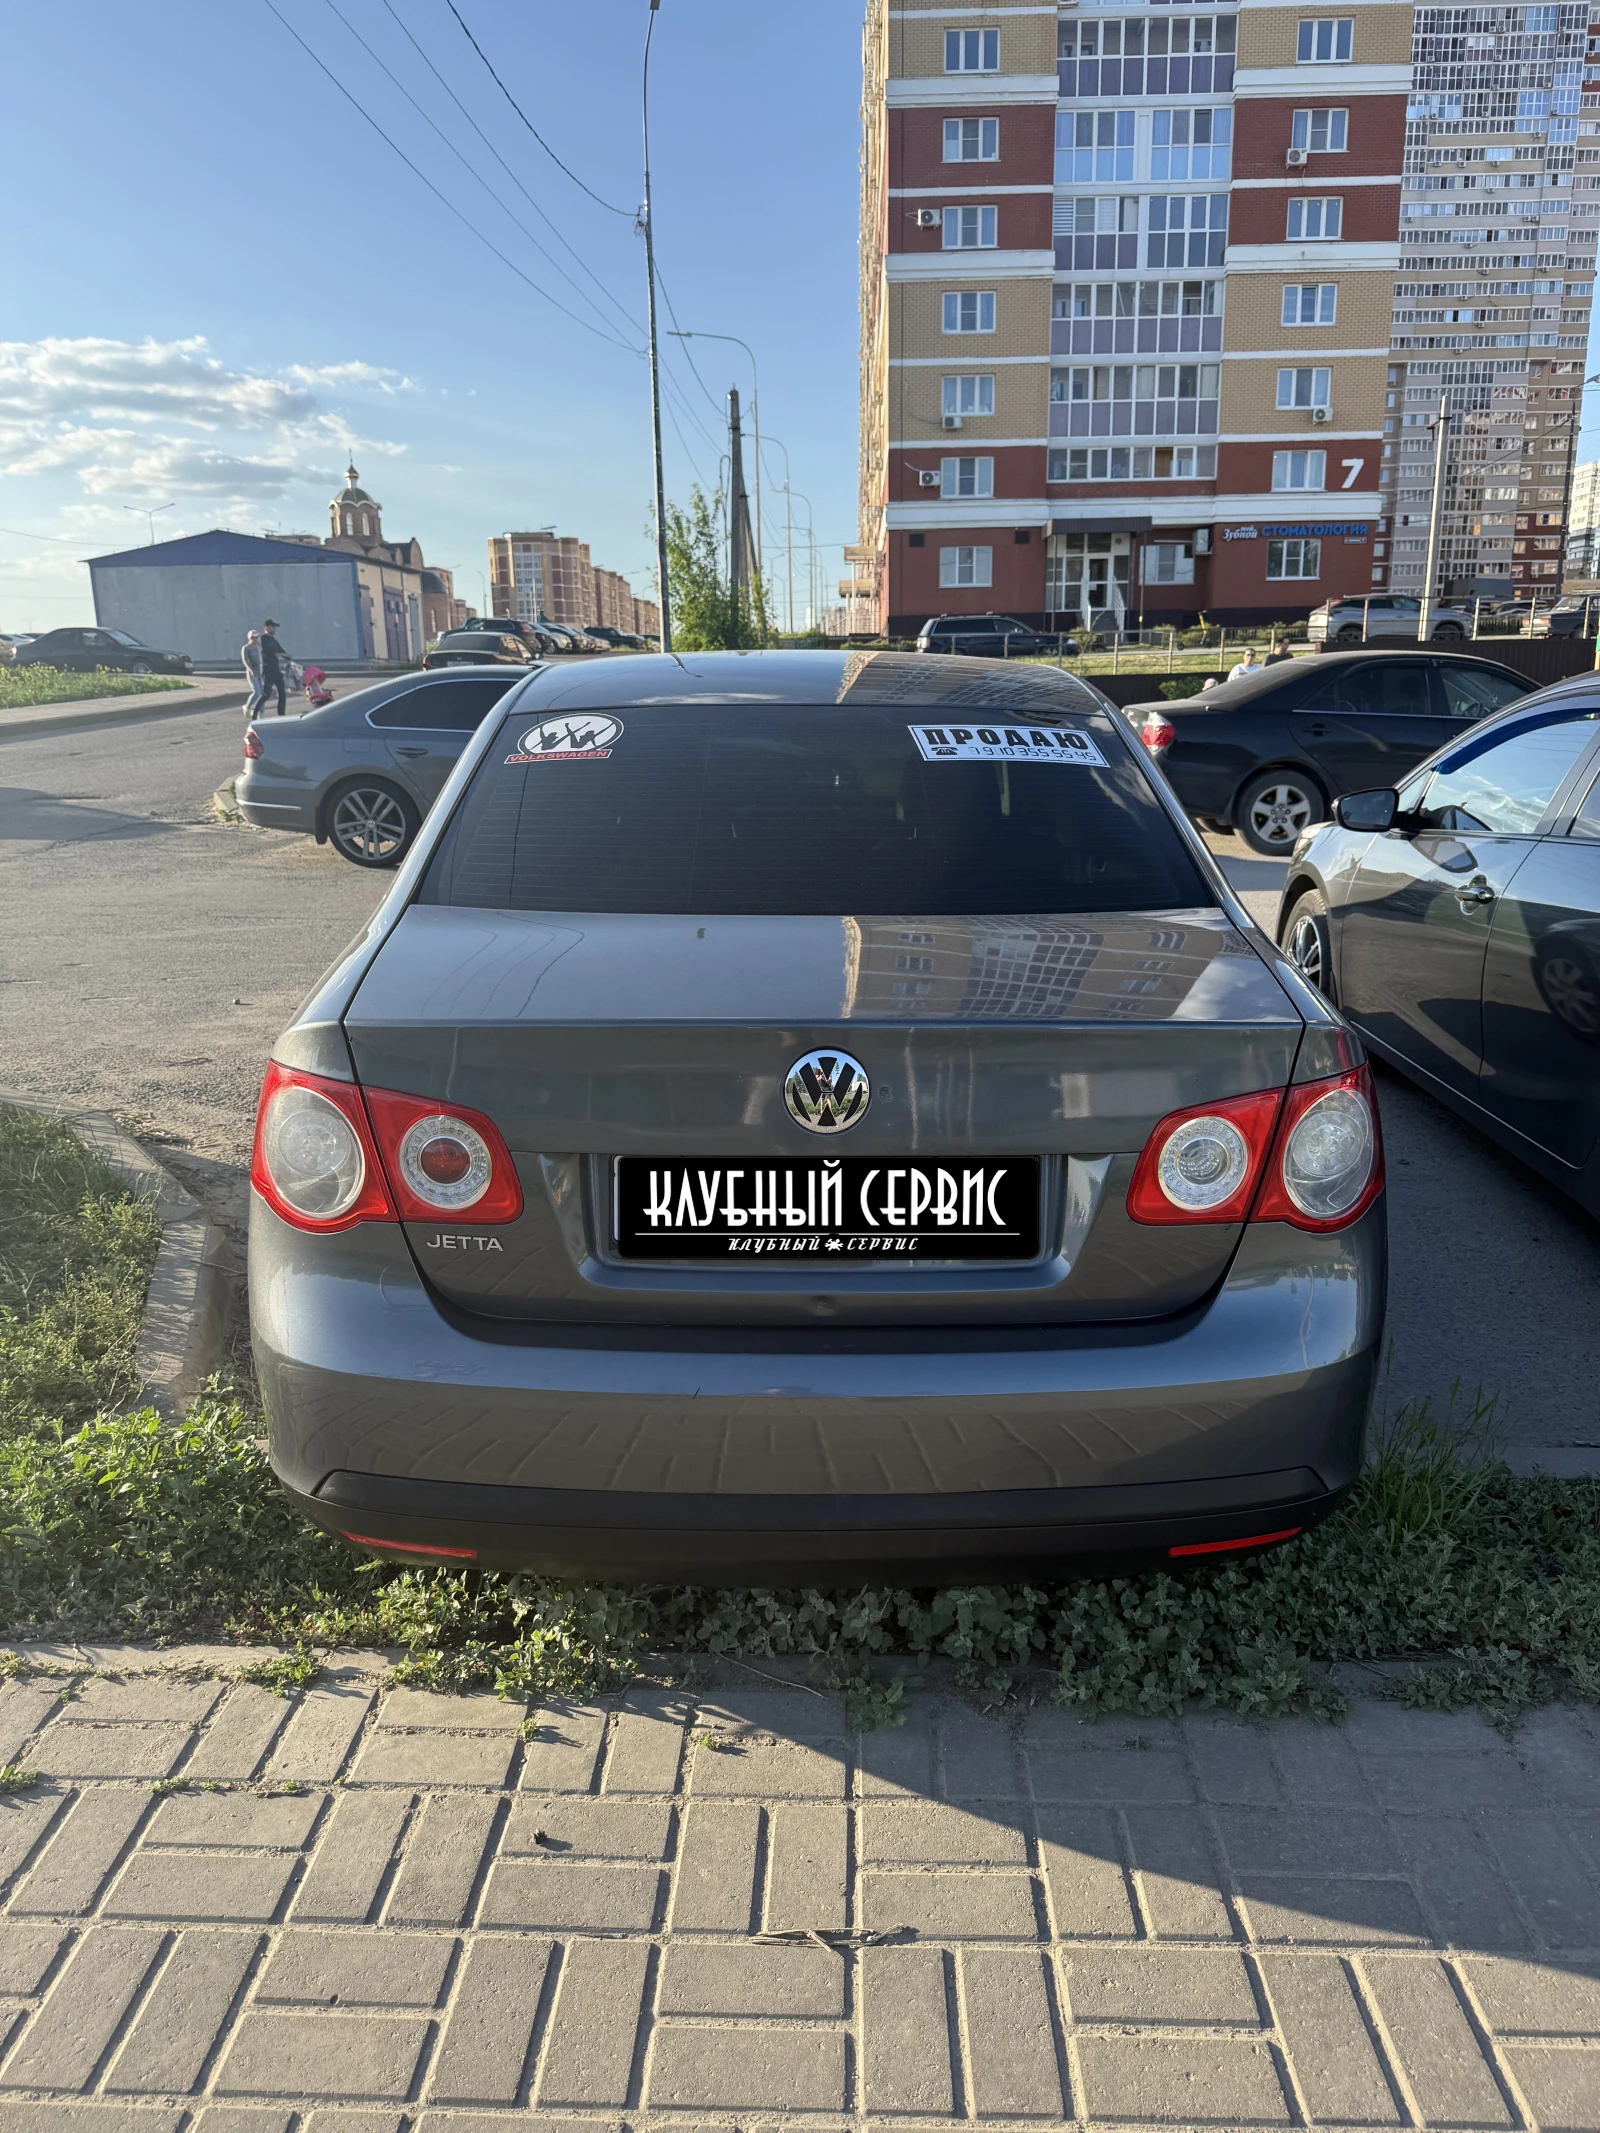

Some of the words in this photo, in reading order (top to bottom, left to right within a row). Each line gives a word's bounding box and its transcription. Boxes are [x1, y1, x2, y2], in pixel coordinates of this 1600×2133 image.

[1341, 458, 1364, 488] 7
[1222, 528, 1258, 541] Зубной
[1261, 524, 1368, 537] СТОМАТОЛОГИЯ
[922, 729, 1089, 750] ПРОДАЮ
[509, 751, 607, 762] VOLKSWAGEN
[426, 1234, 504, 1252] JETTA
